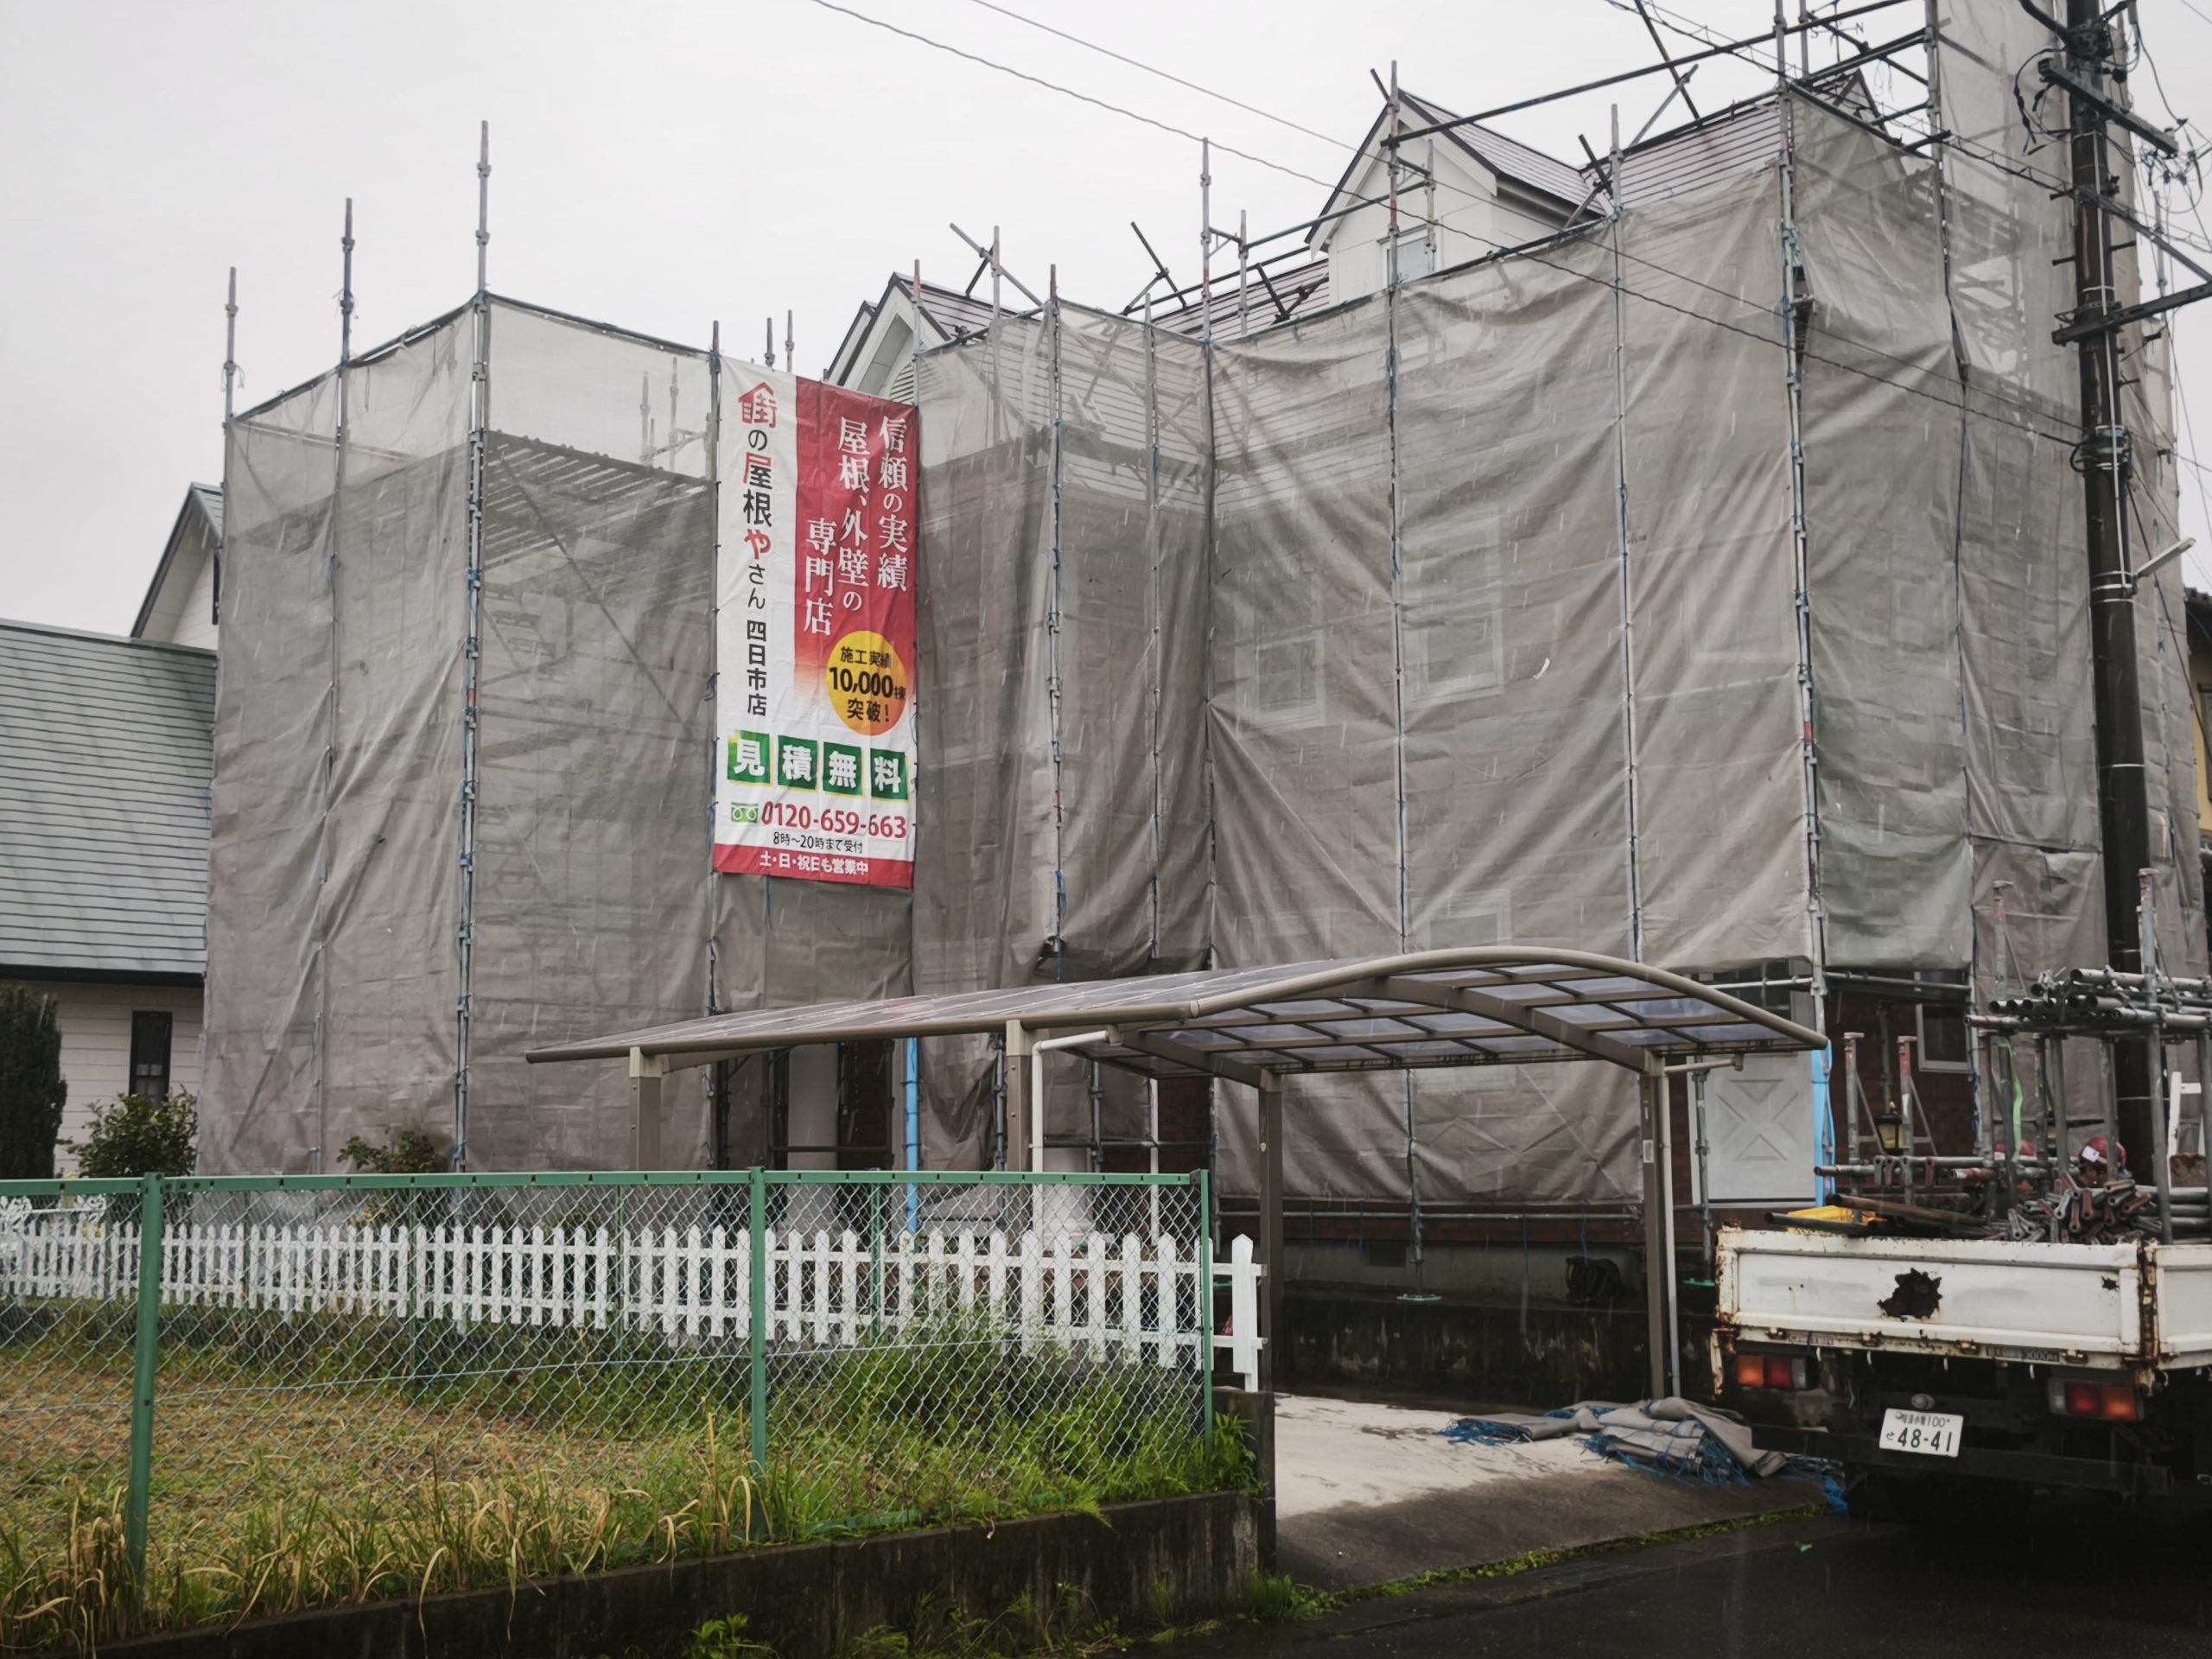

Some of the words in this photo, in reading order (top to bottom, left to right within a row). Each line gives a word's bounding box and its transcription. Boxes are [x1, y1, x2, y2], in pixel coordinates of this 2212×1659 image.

[739, 382, 777, 609] 街の屋根やさん
[838, 416, 871, 611] 屋根、外壁の
[878, 416, 908, 592] 信頼の実績
[804, 518, 837, 635] 専門店
[746, 620, 767, 716] 四日市店
[841, 645, 892, 669] 施工実績
[847, 698, 889, 723] 突破!
[734, 738, 901, 794] 見積無料
[761, 801, 907, 839] 0120-659-663
[773, 831, 863, 854] 8時〜20時まで受付
[760, 850, 869, 876] 土・日・祝日も営業中
[1897, 1427, 1953, 1452] 48-41
